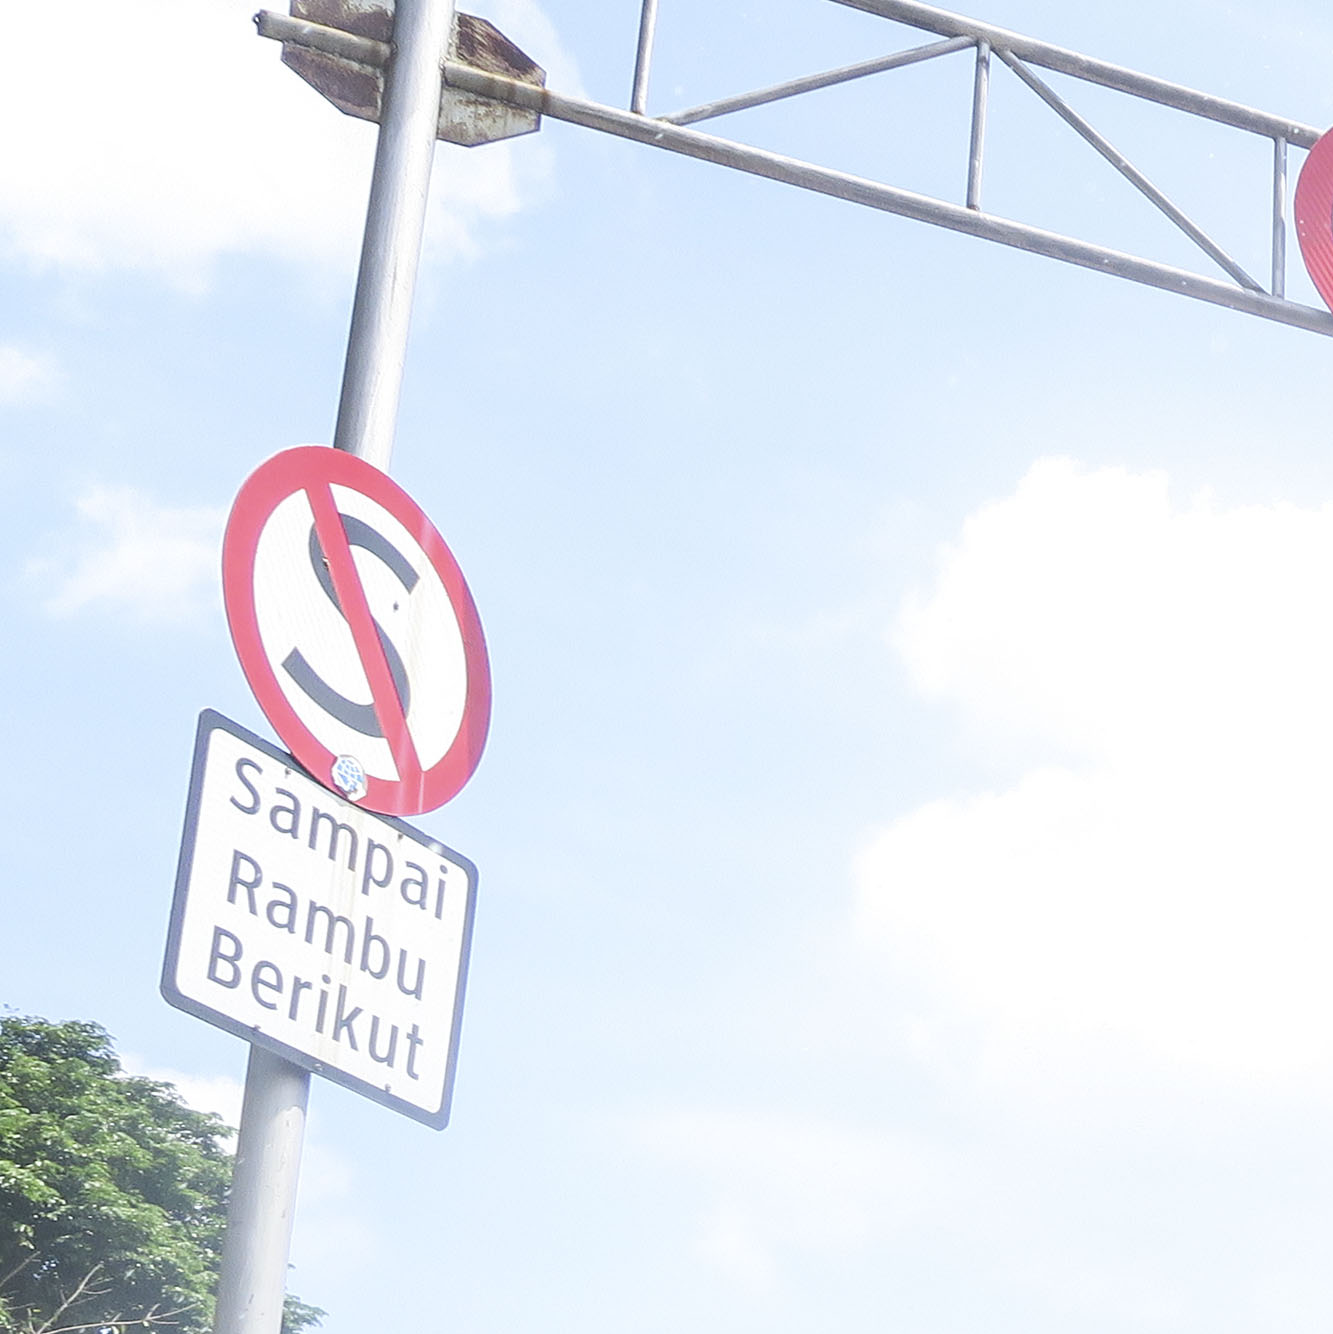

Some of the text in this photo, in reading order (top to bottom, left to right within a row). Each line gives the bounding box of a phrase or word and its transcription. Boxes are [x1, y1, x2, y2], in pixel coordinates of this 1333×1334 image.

[229, 756, 450, 920] Sampai
[206, 924, 424, 1081] Berikut
[226, 850, 427, 1001] Rambu
